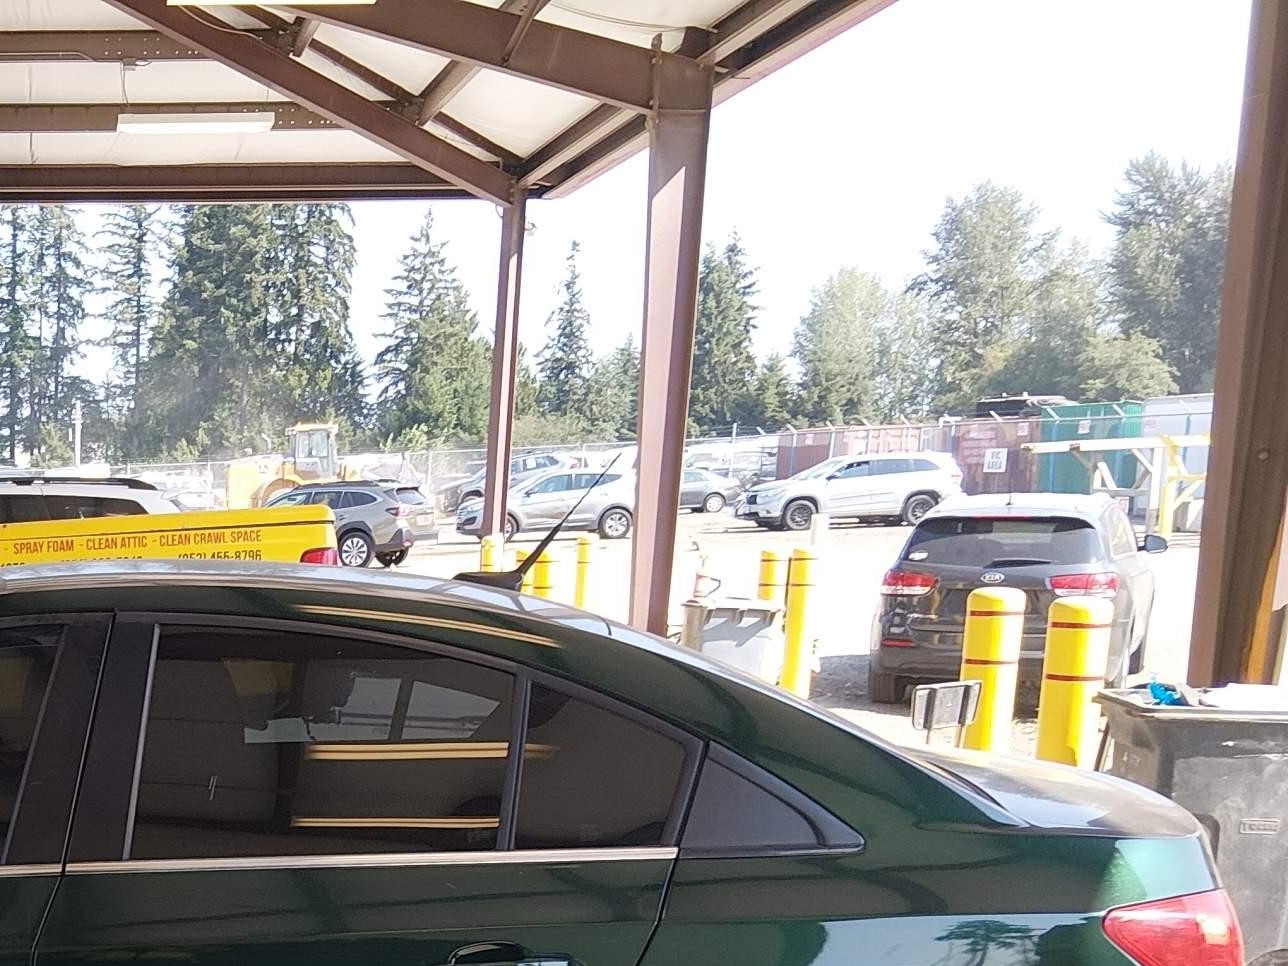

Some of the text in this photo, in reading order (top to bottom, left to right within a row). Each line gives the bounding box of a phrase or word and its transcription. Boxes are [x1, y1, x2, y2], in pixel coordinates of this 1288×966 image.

[13, 541, 44, 555] SPRAY
[47, 539, 74, 553] FOAM
[86, 537, 118, 551] CLEAN
[120, 535, 147, 549] ATTIC
[159, 533, 191, 547] CLEAN
[194, 531, 228, 545] CRAWL
[231, 530, 262, 543] SPACE
